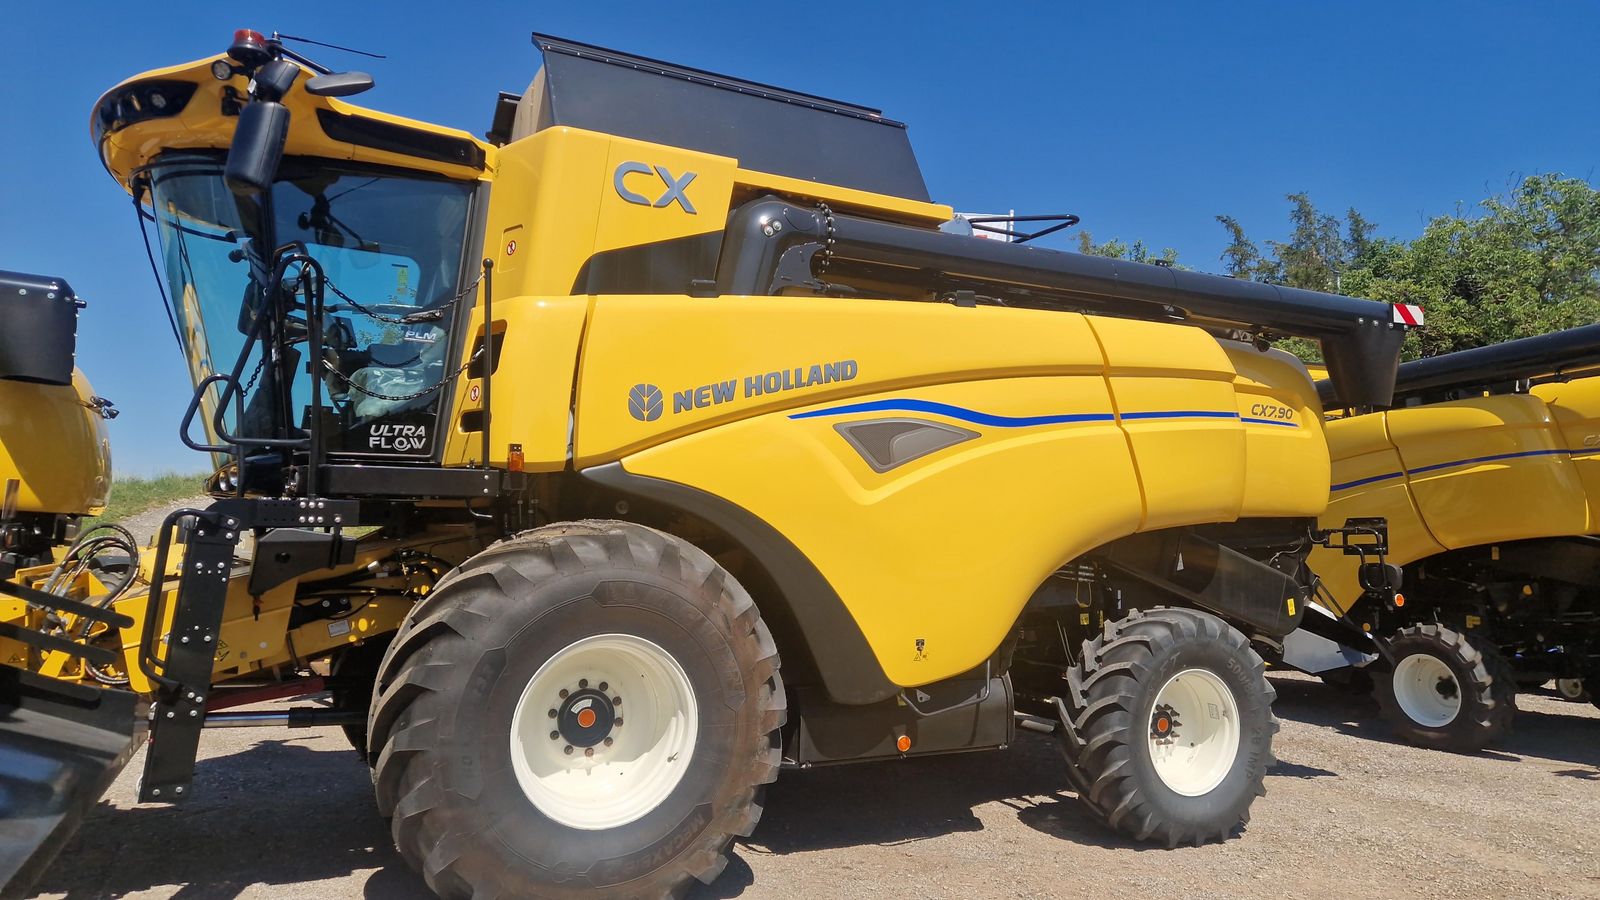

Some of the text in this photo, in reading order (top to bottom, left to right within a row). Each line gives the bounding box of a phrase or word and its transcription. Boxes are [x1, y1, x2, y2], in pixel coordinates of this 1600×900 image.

[613, 161, 698, 215] CX
[404, 331, 437, 340] PLM
[673, 359, 858, 414] NEW HOLLAND
[1251, 403, 1293, 420] CX7.90
[370, 424, 426, 437] ULTRA
[369, 437, 427, 452] FLOW
